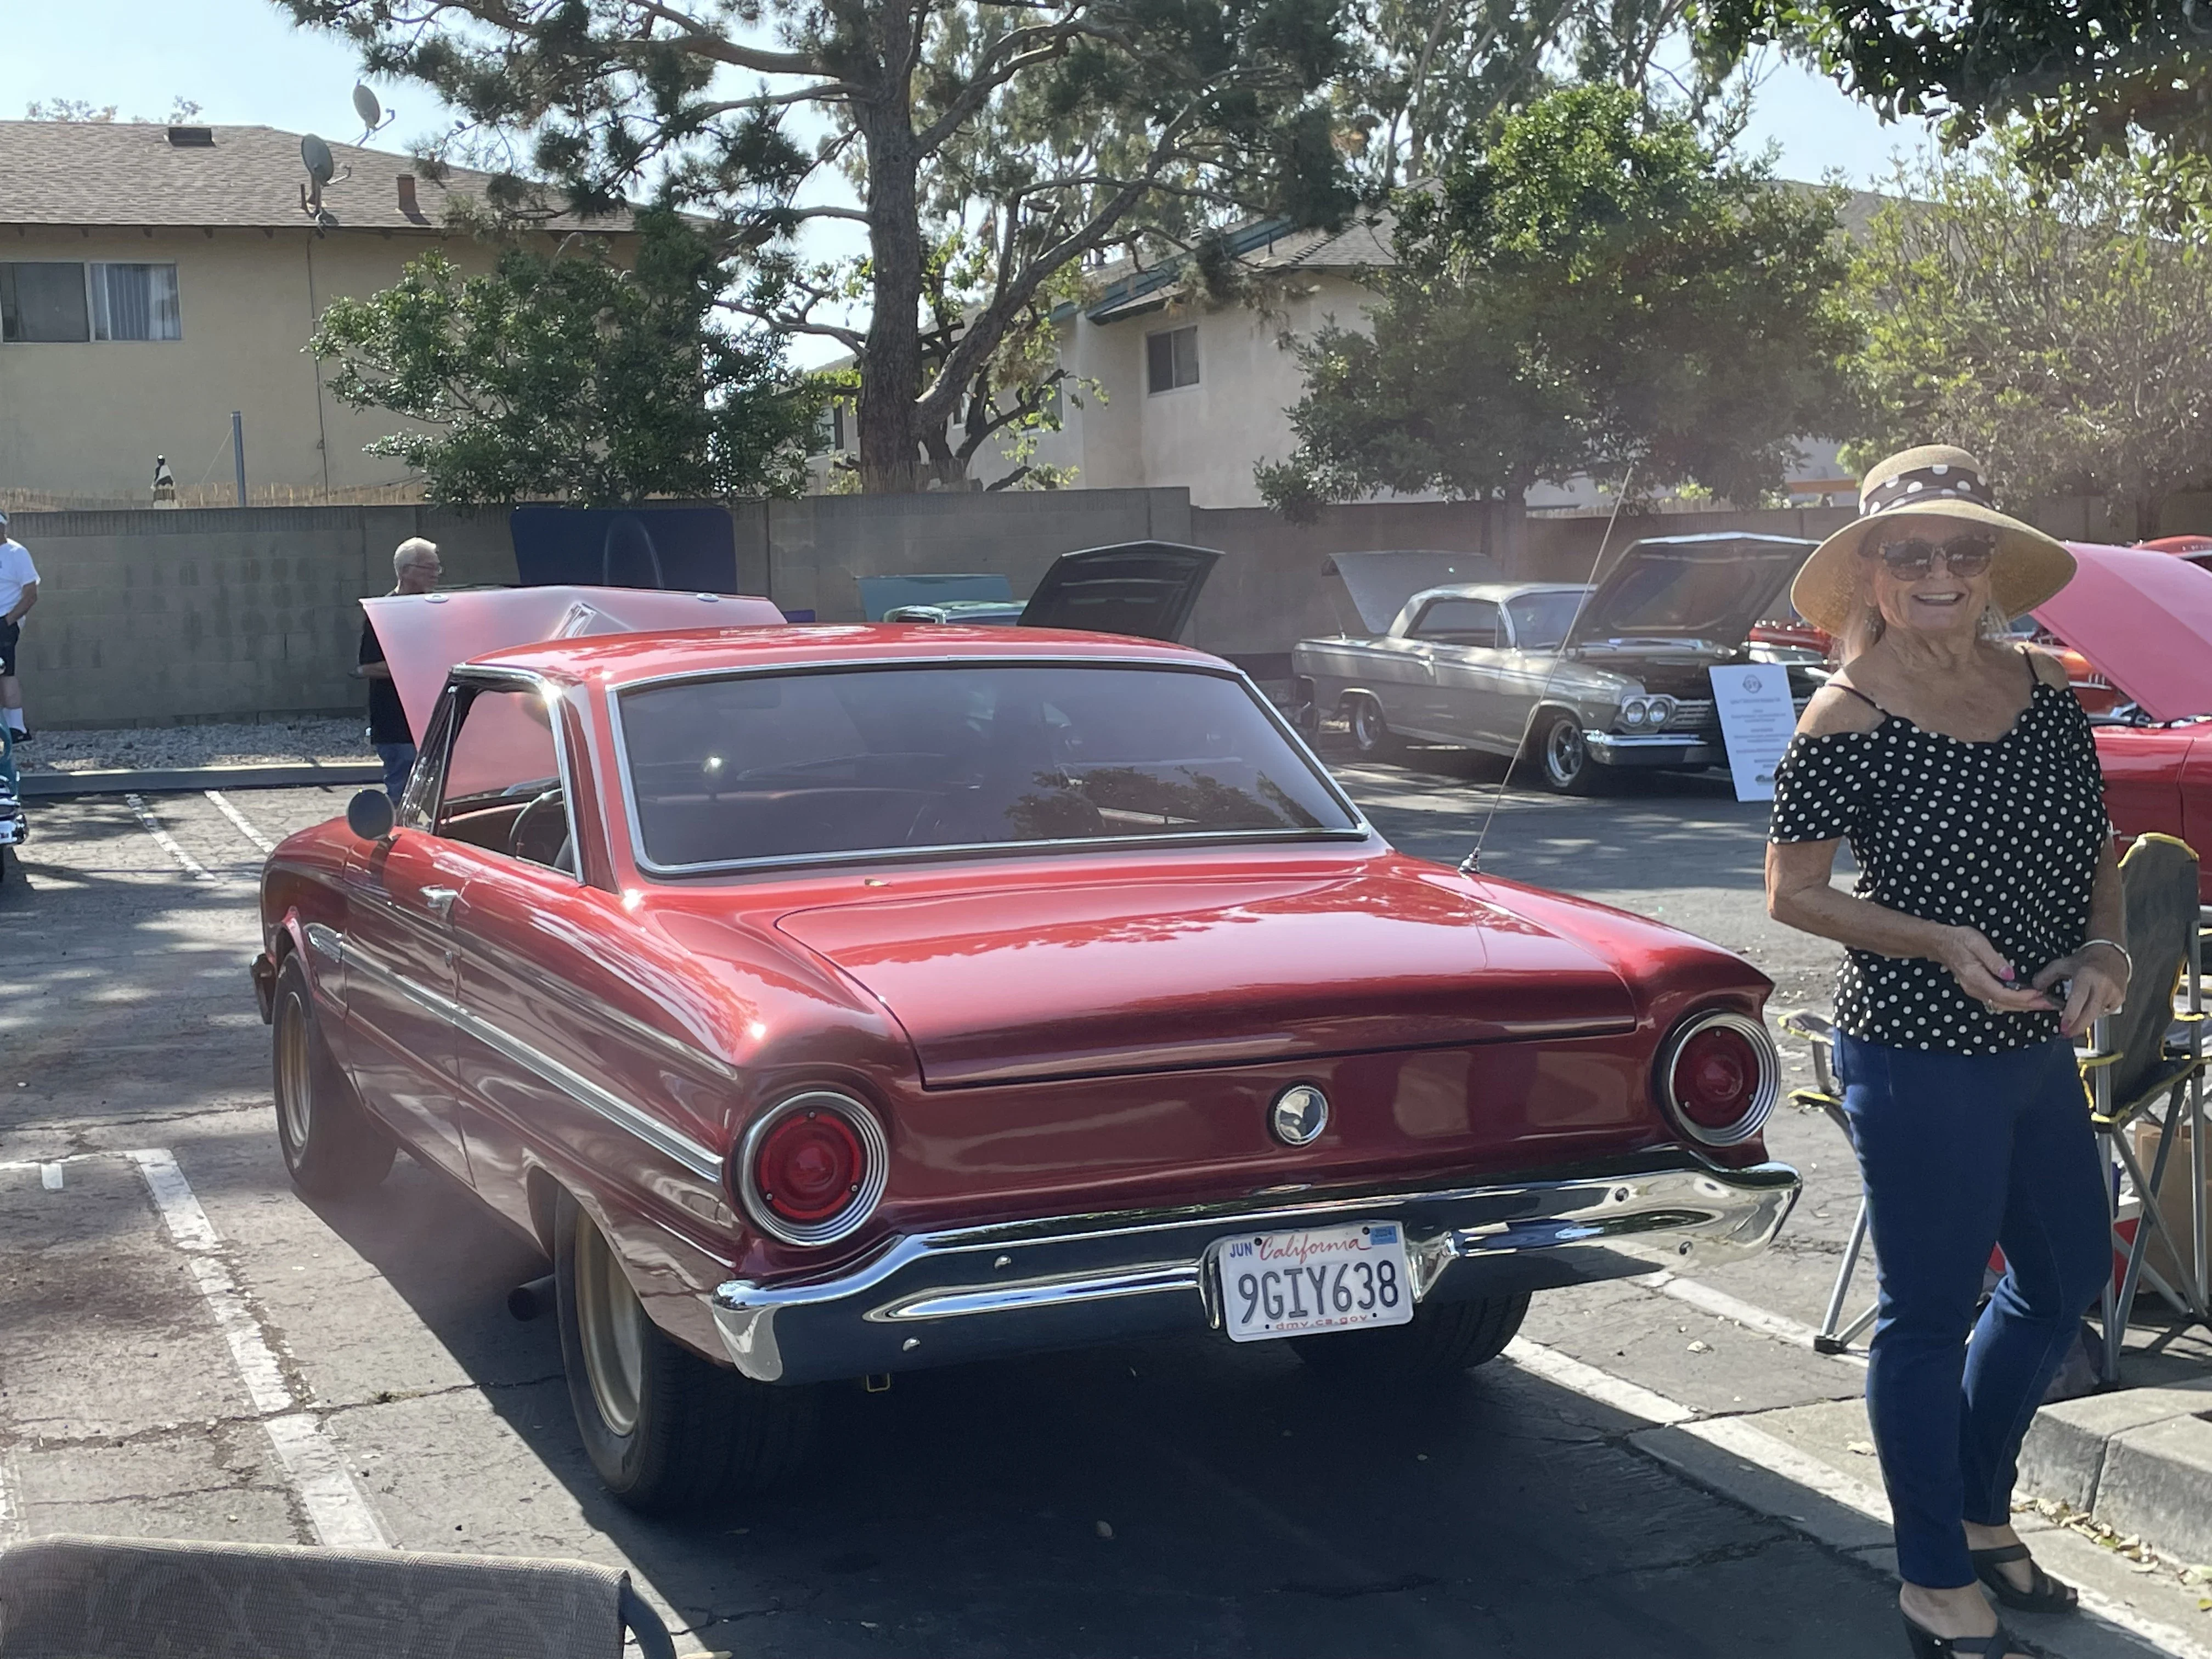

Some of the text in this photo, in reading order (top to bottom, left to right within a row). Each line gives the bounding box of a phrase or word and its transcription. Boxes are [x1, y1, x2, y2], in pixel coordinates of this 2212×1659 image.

[1230, 1242, 1252, 1258] JUN
[1260, 1234, 1372, 1264] California
[1238, 1260, 1398, 1323] 9GIY638
[1276, 1315, 1367, 1330] dmv.ca.gov
